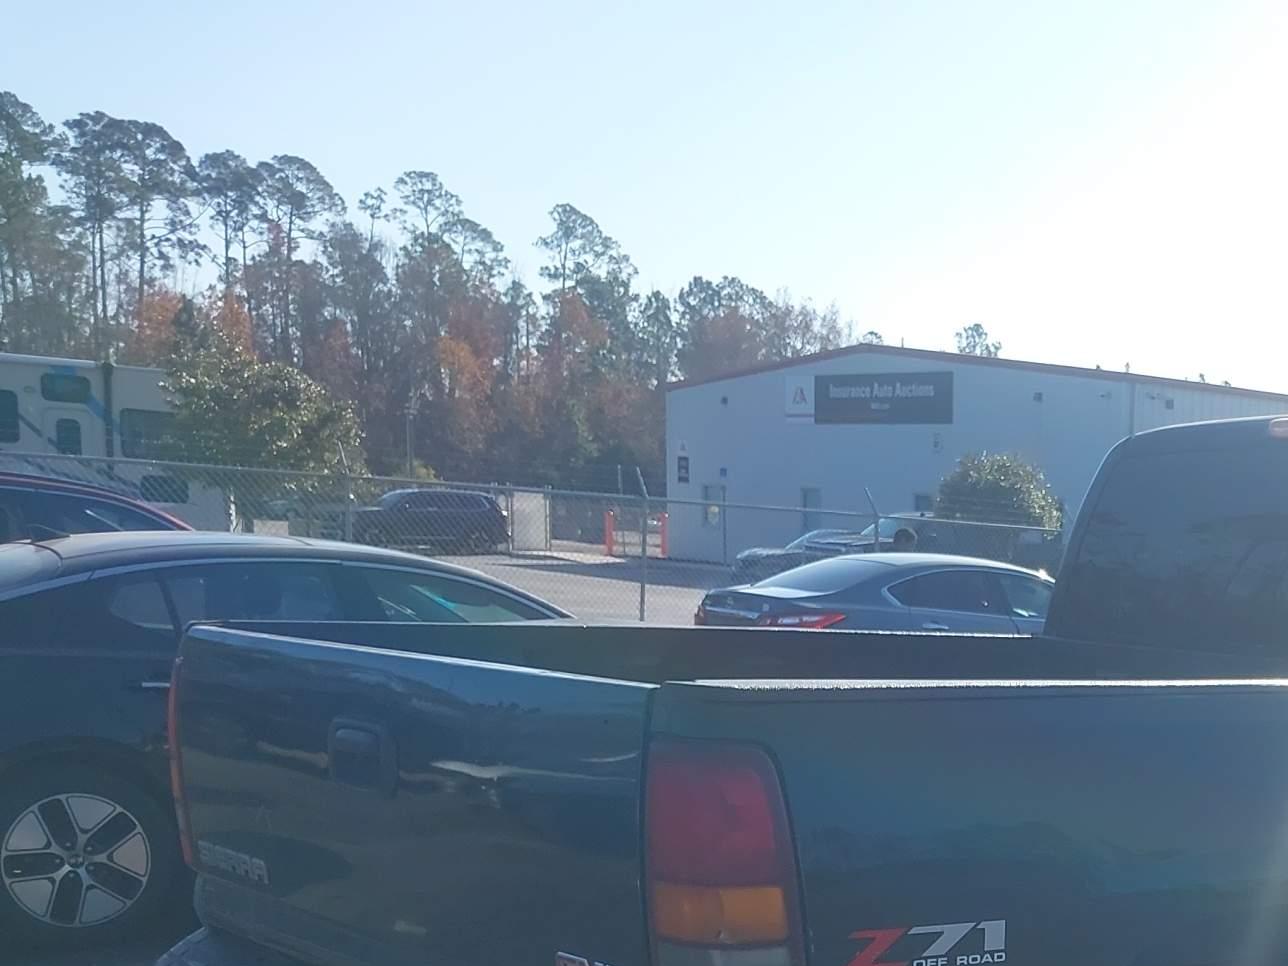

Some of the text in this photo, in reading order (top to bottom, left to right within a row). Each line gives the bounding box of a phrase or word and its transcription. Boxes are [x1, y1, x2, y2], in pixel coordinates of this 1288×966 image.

[829, 382, 935, 399] Insurance Auto Auctions
[956, 952, 1006, 966] ROAD
